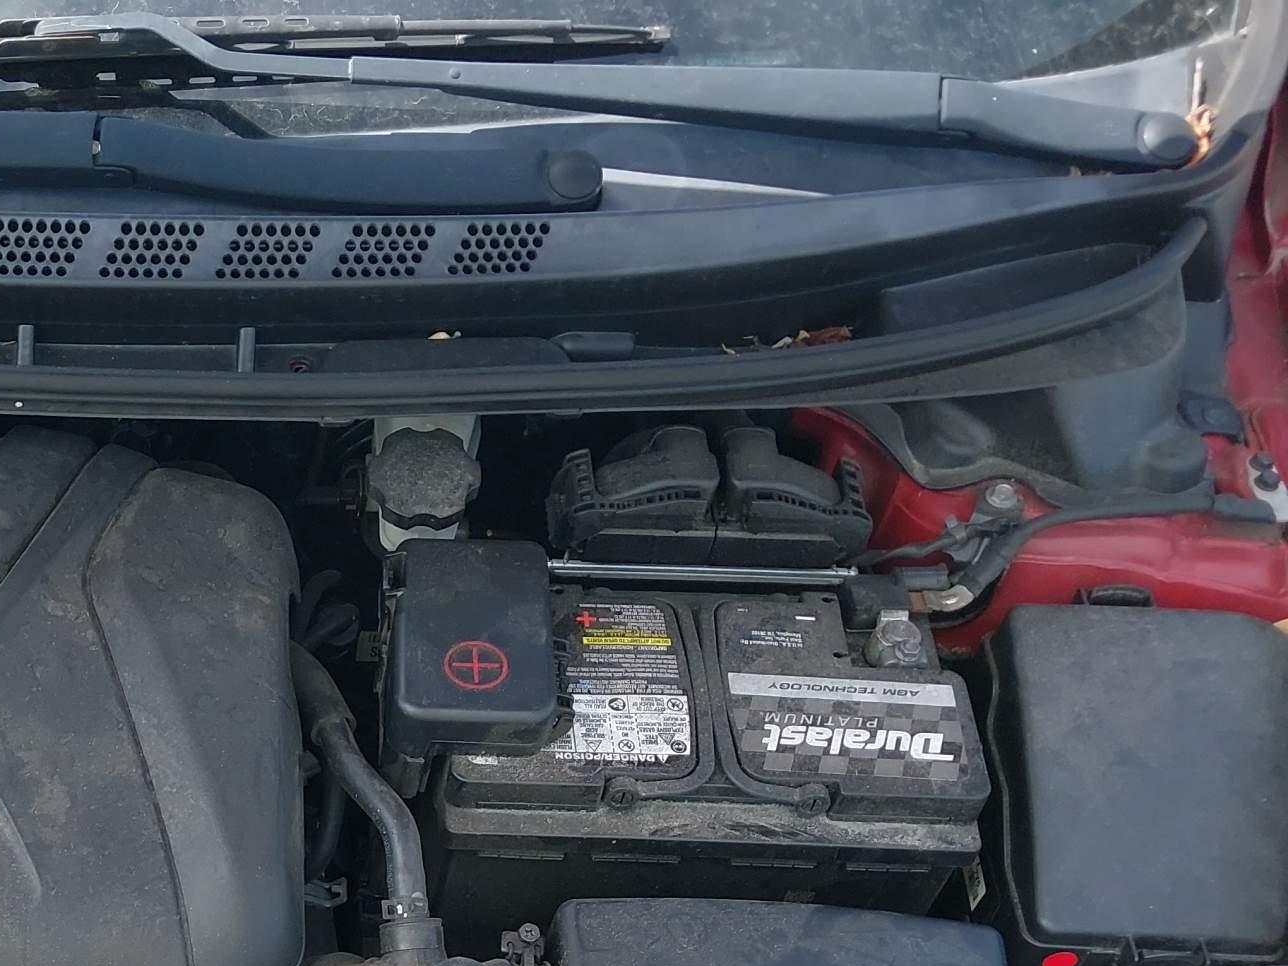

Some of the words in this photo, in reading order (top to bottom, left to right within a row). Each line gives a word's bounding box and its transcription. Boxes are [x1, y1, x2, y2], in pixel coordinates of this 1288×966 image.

[768, 682, 876, 695] TECHNOLOGY
[882, 687, 920, 697] AGM
[764, 711, 878, 728] PLATINUM
[762, 724, 955, 761] Duralast
[555, 752, 655, 762] DANGER/POISON
